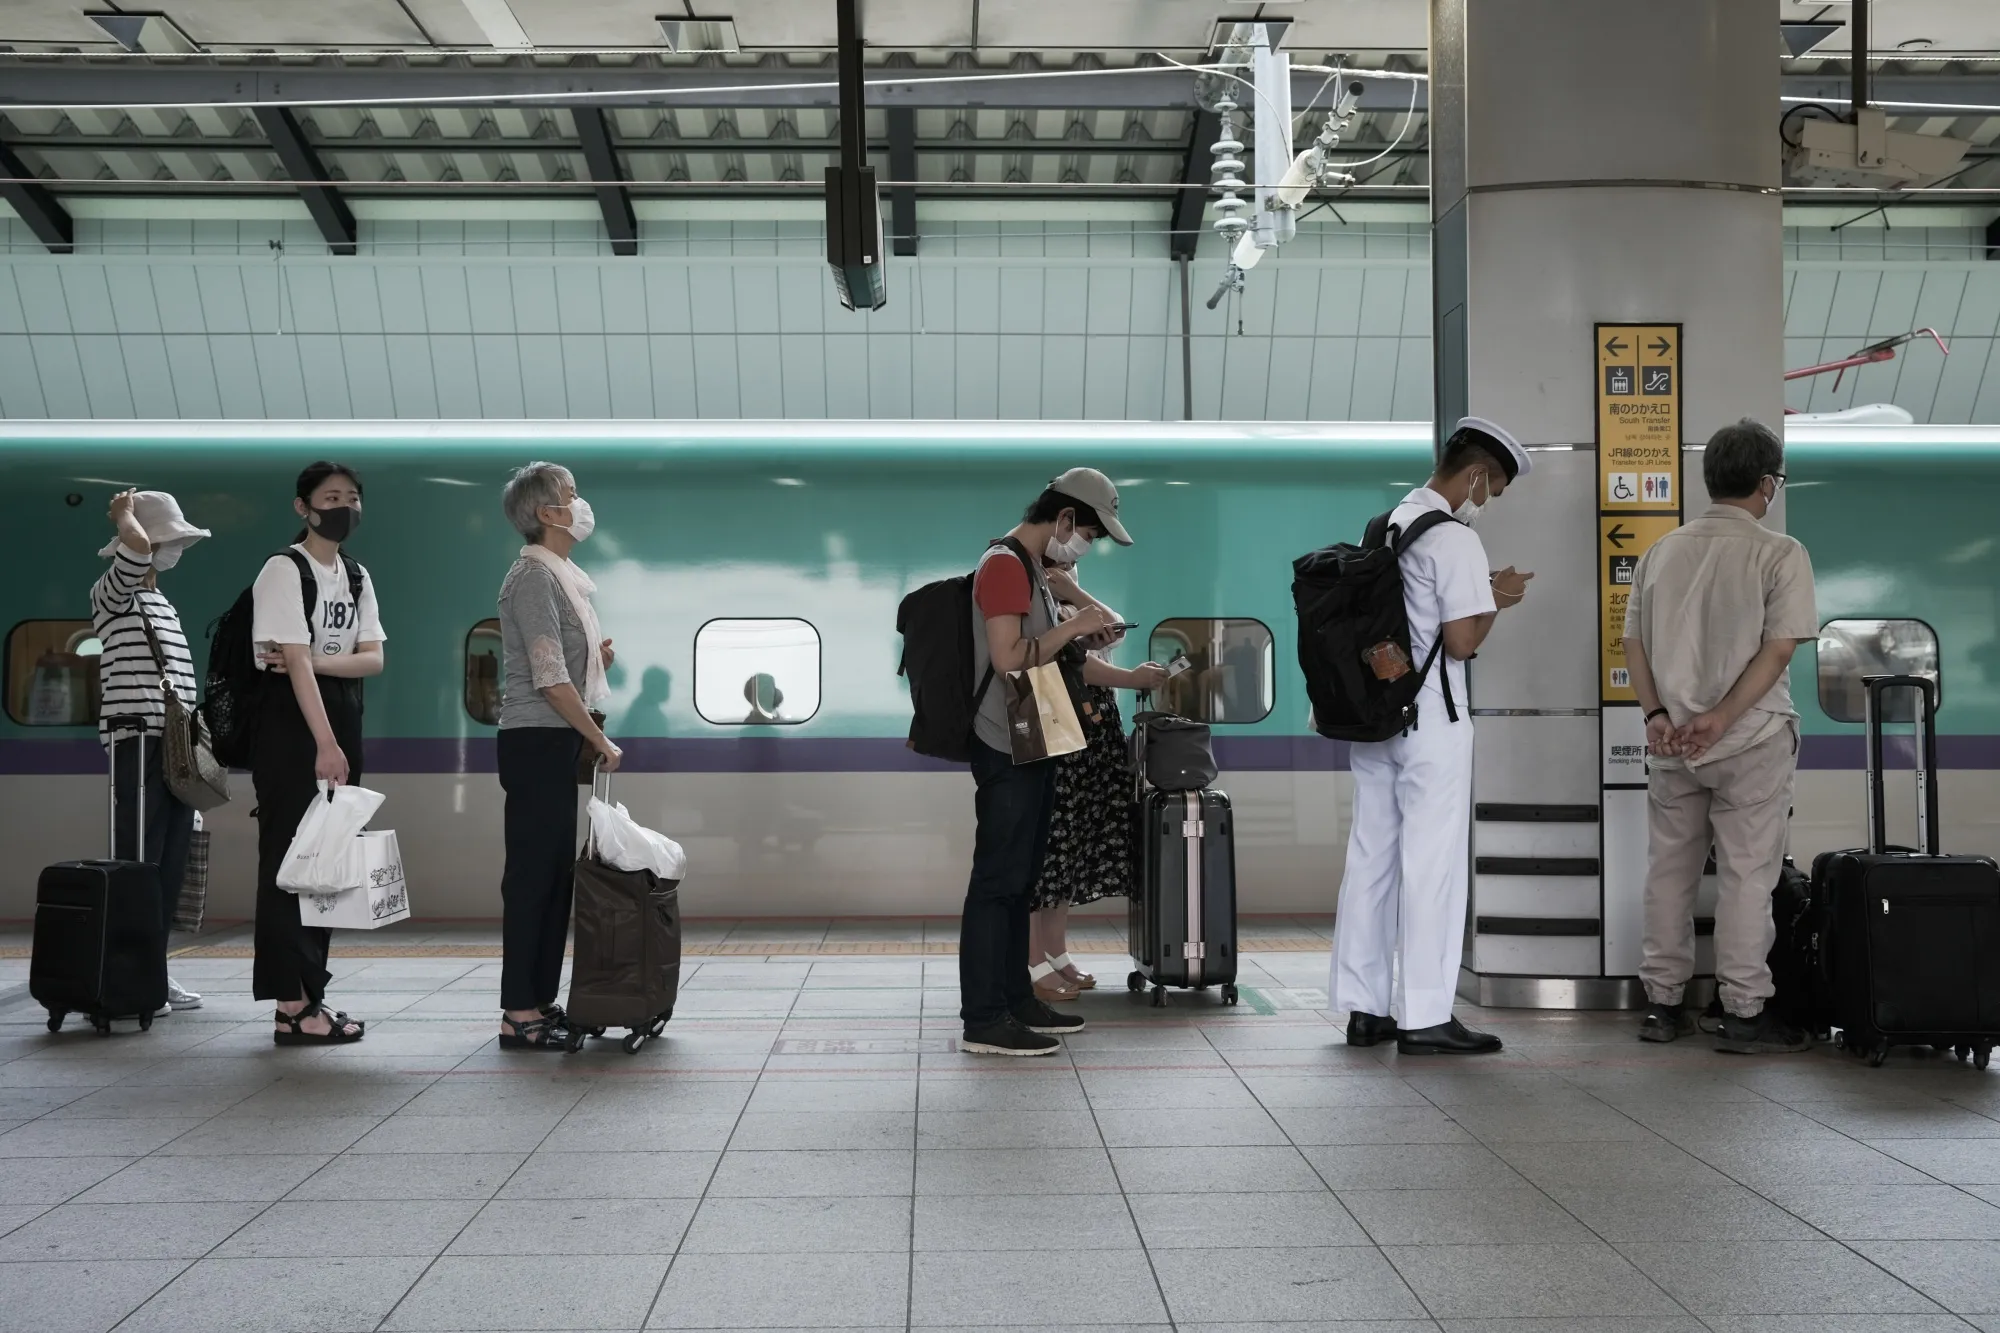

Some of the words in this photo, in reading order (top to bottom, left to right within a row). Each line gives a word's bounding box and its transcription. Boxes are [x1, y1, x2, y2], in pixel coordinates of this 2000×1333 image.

[1609, 403, 1671, 415] 南のりかえ口
[1619, 416, 1640, 424] South
[1641, 416, 1671, 424] Transfer
[1608, 447, 1671, 458] JR線のりかえ
[1611, 745, 1643, 756] 喫煙所
[1608, 757, 1630, 765] Smoking
